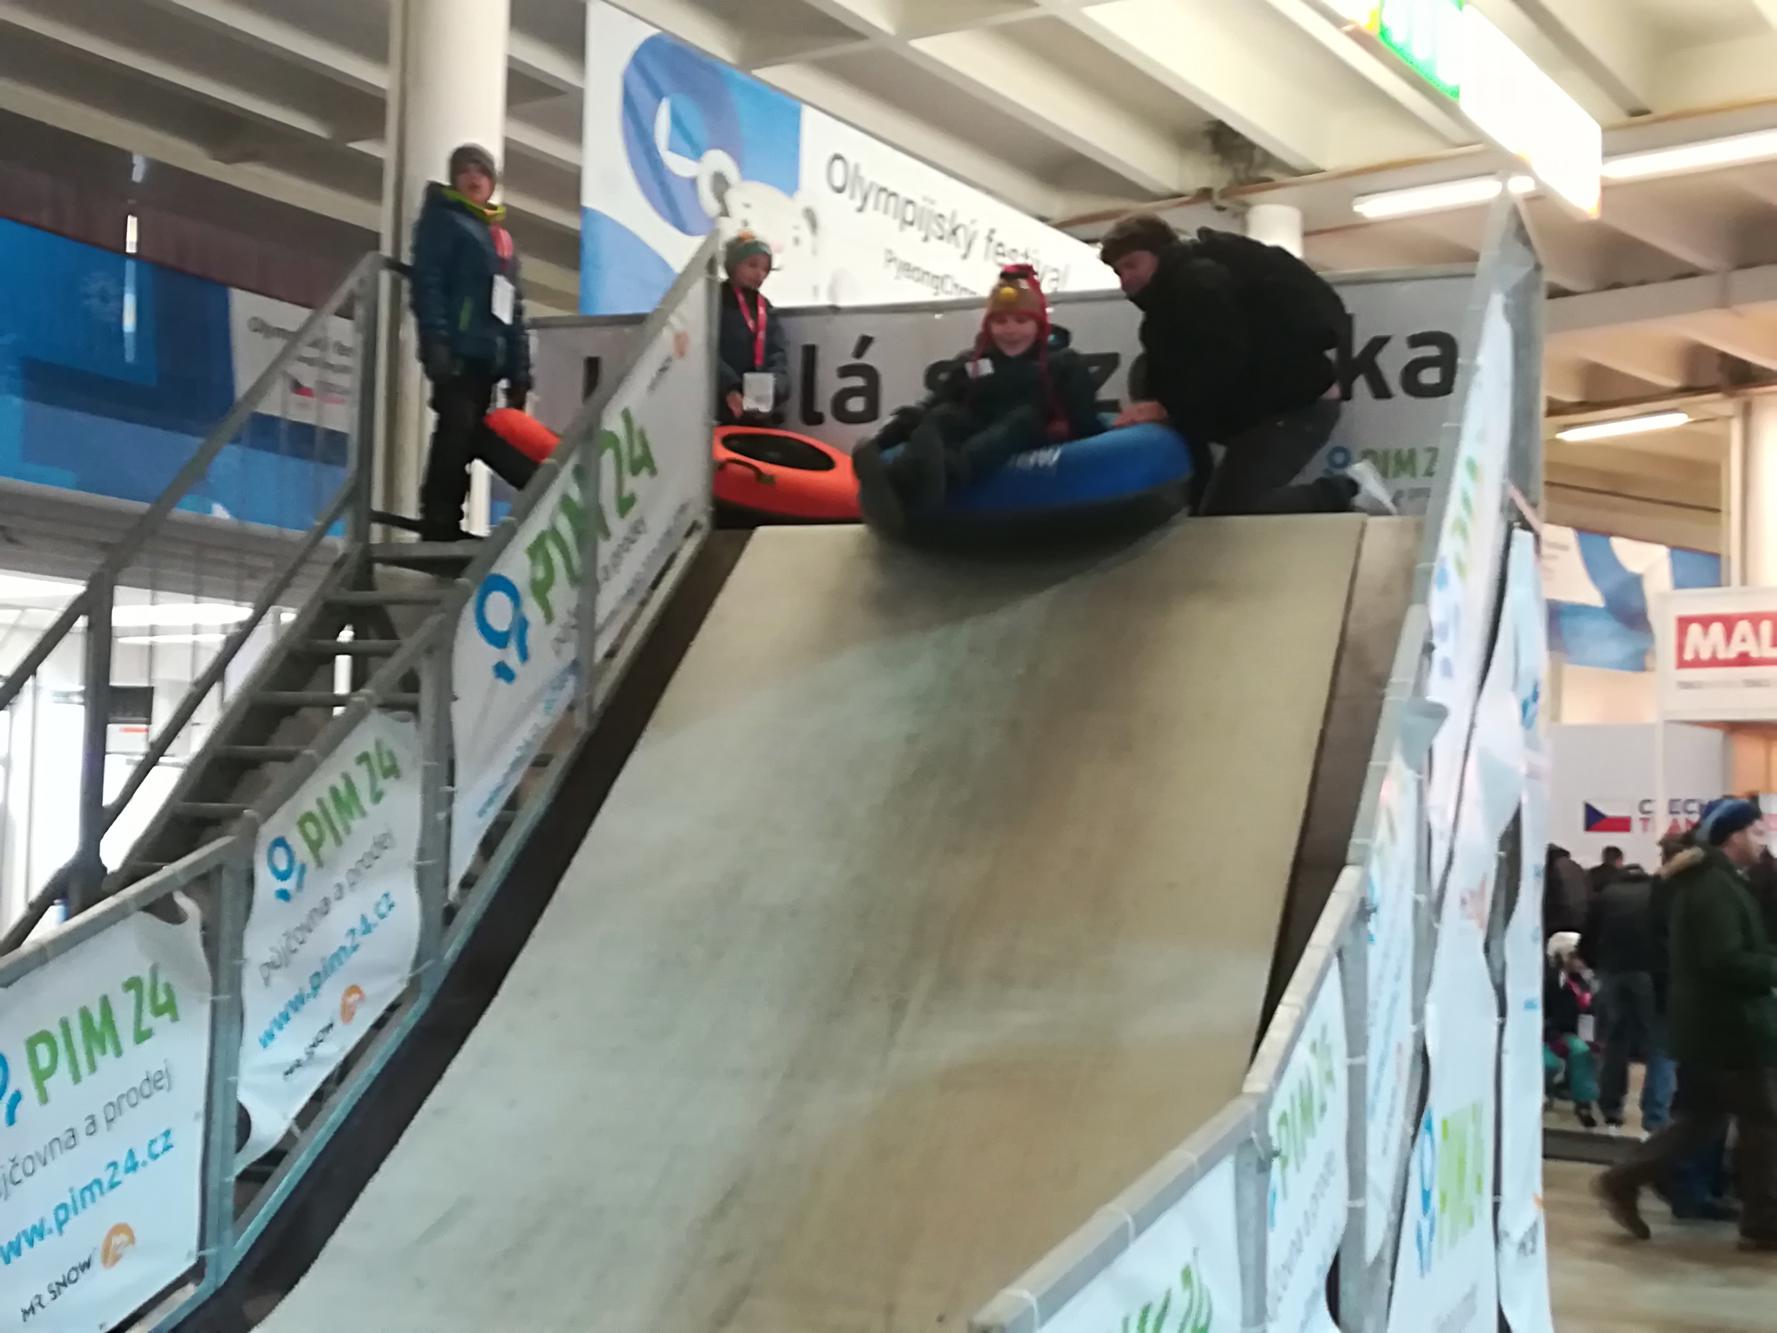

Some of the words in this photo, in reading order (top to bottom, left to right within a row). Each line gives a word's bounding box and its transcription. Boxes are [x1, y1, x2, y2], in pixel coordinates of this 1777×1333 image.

[826, 153, 978, 260] Olympijský
[259, 892, 396, 1048] www.pim24.cz
[84, 1113, 98, 1137] a
[102, 1057, 174, 1133] prodej
[47, 1253, 93, 1303] SNOW
